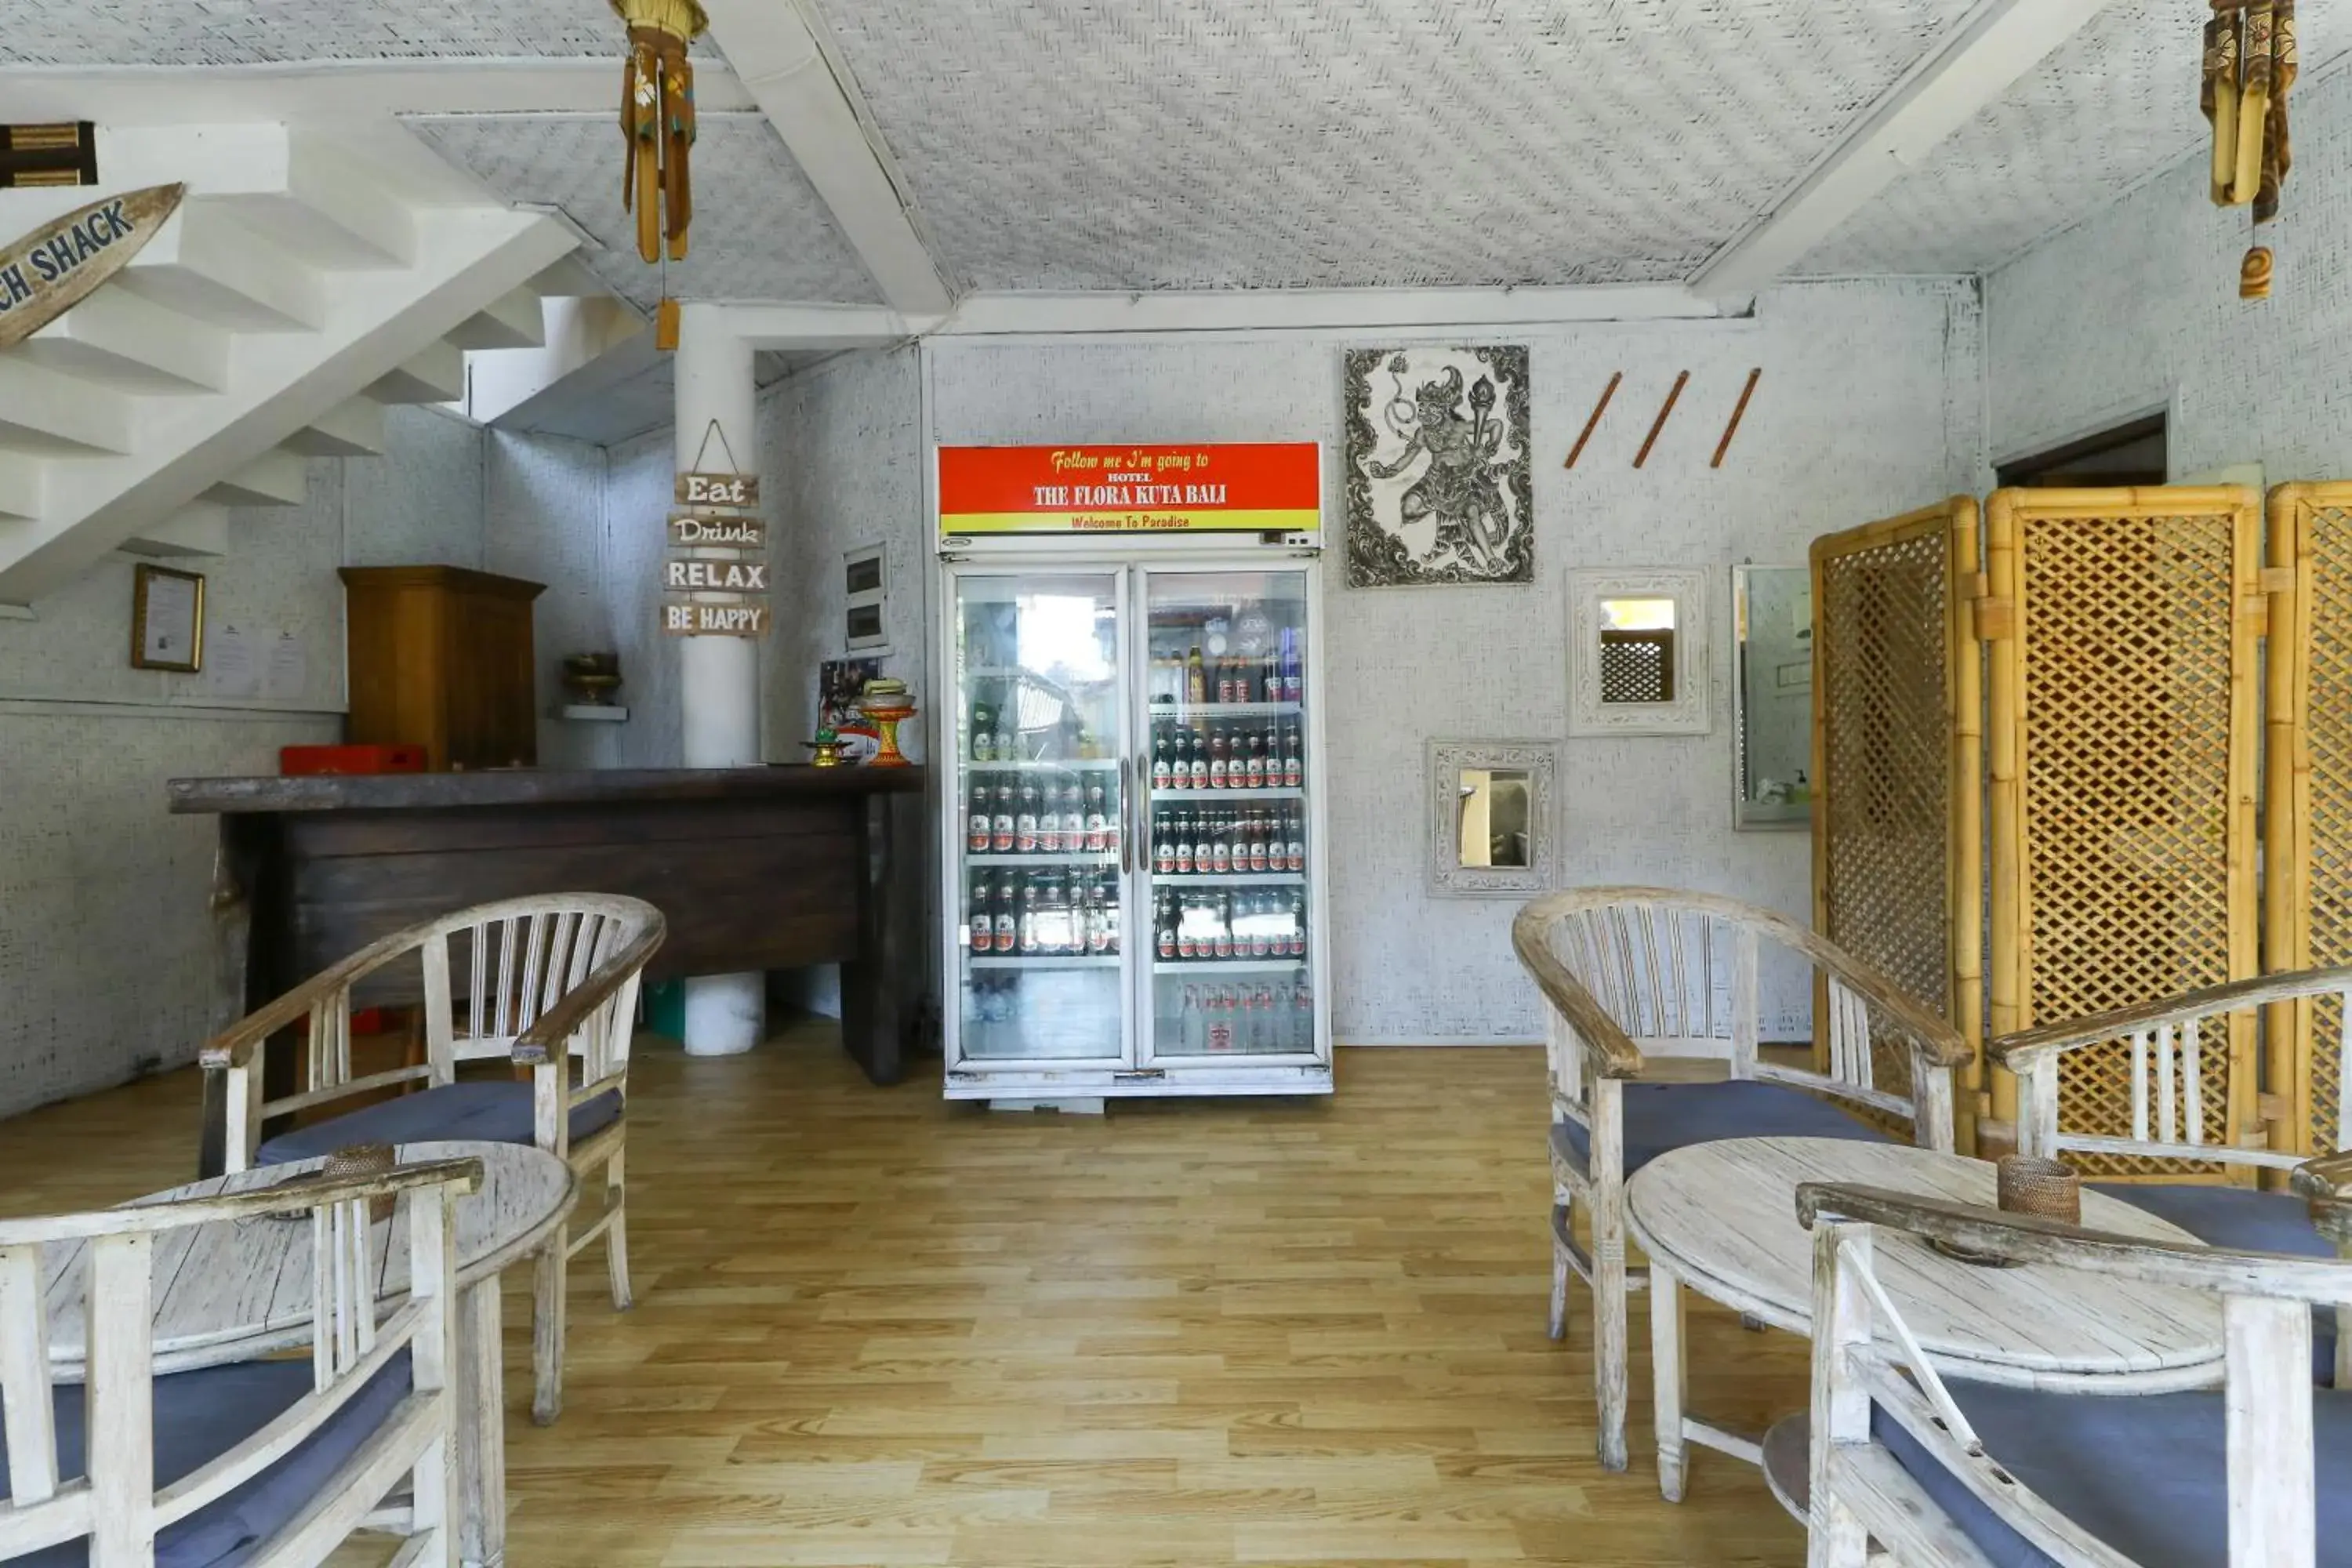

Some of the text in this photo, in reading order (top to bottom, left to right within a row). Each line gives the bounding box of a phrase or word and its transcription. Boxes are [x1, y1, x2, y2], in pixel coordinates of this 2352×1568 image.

[31, 200, 133, 281] SHACK
[1051, 449, 1208, 474] Follow me I'm going to
[687, 476, 746, 503] Eat
[1107, 473, 1153, 482] HOTEL
[1033, 484, 1226, 506] THE FLORA KUTA BALI
[674, 518, 758, 543] Drink
[1071, 514, 1189, 528] Welcome To Paradise
[668, 561, 764, 589] RELAX
[667, 605, 761, 631] BE HAPPY
